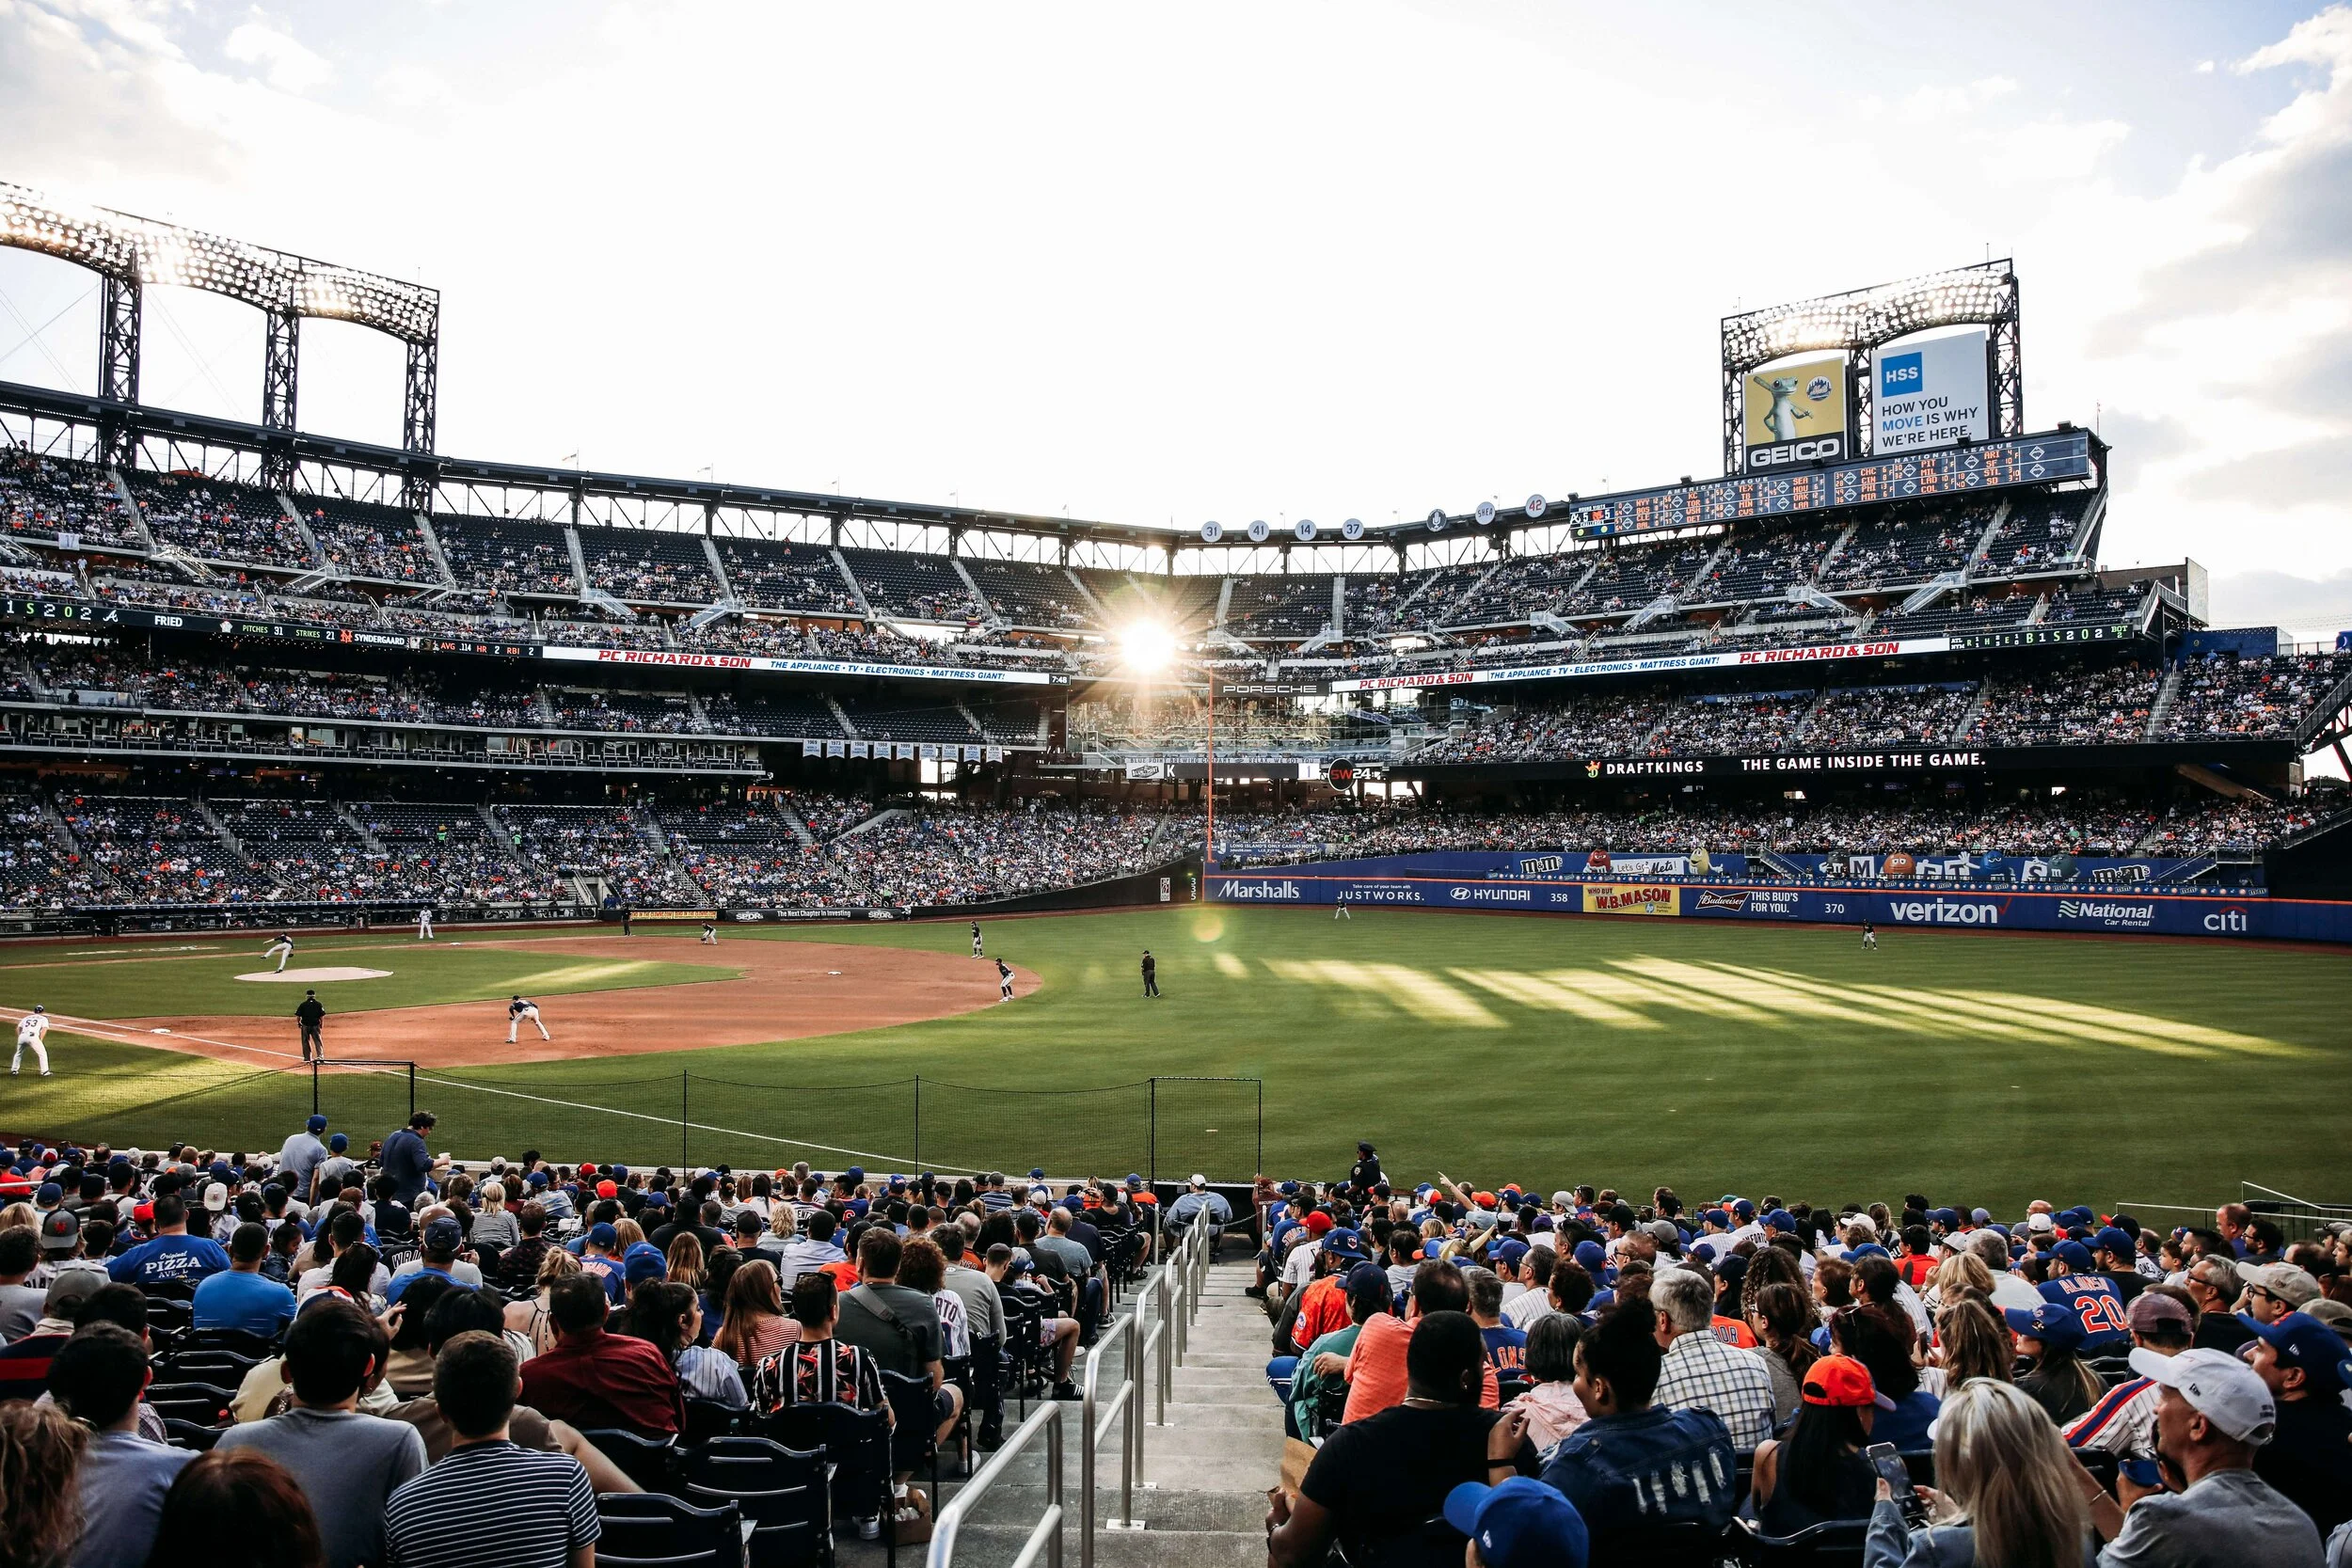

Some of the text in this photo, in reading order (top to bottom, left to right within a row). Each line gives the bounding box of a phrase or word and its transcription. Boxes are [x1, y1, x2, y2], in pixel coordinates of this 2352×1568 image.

[1885, 367, 1918, 384] HSS
[1882, 396, 1948, 417] HOW YOU
[1882, 406, 1979, 432] MOVE IS WHY
[1882, 425, 1972, 448] WE'RE HERE.
[1750, 437, 1840, 467] GEICO
[1894, 442, 2012, 464] NATIONAL LEAGUE
[1983, 451, 2000, 460] ARI
[1920, 459, 1936, 468] PIT
[1986, 460, 1996, 468] SF
[1860, 467, 1877, 476] CHC
[1920, 467, 1936, 477] MIL
[1983, 468, 2001, 477] STL
[1861, 476, 1876, 484] CIN
[1920, 476, 1937, 485] LAD
[1667, 476, 1769, 496] AMERICAN LEAGUE
[1739, 484, 1754, 493] TEX
[1861, 483, 1876, 493] PHI
[1920, 485, 1937, 494] COL
[1688, 492, 1698, 500] KC
[1740, 492, 1751, 500] TB
[1861, 492, 1877, 501] MIA
[1529, 499, 1542, 511] 42
[1686, 499, 1701, 508] TOR
[1477, 507, 1493, 518] SHEA
[1738, 508, 1754, 516] CWS
[1206, 527, 1217, 537] 31
[1253, 525, 1265, 536] 41
[1300, 524, 1311, 535] 14
[1346, 524, 1359, 534] 37
[7, 600, 14, 614] 1
[26, 603, 35, 614] S
[43, 603, 56, 617] 2
[80, 607, 91, 621] 2
[154, 614, 183, 627] FRIED
[242, 624, 268, 634] PITCHES
[274, 626, 283, 636] 31
[295, 628, 321, 639] STRIKES
[326, 630, 335, 641] 21
[2005, 636, 2010, 644] E
[2026, 633, 2034, 643] B
[2040, 632, 2046, 642] 1
[2053, 631, 2060, 641] S
[2066, 629, 2074, 641] 2
[2094, 627, 2103, 639] 2
[354, 634, 405, 646] SYNDERGAARD
[440, 641, 455, 651] AVG
[459, 642, 471, 652] .114
[476, 645, 487, 654] HR
[494, 645, 501, 655] 2
[506, 646, 519, 656] RBI
[529, 647, 534, 657] 2
[1984, 638, 1991, 646] H
[1739, 641, 1899, 664] P.C. RICHARD & SON
[598, 650, 752, 668] P.C. RICHARD & SON
[789, 662, 841, 673] APPLIANCE
[865, 666, 926, 676] ELECTRONICS
[931, 669, 976, 679] MATTRESS
[1490, 671, 1505, 680] THE
[1507, 668, 1551, 678] APPLIANCE
[1574, 662, 1633, 673] ELECTRONICS
[1639, 659, 1687, 669] MATTRESS
[1689, 657, 1720, 666] GIANT!
[1051, 675, 1068, 685] 7:48
[1376, 674, 1436, 688] RICHARD
[1436, 673, 1445, 684] &
[1448, 673, 1473, 683] SON
[1223, 685, 1317, 693] PORSCHE
[1606, 752, 1986, 775] DRAFTKINGS THE GAME INSIDE THE GAME.
[1168, 765, 1175, 777] K
[1617, 863, 1633, 873] Let's
[1853, 860, 1870, 877] M
[1217, 879, 1300, 899] Marshalls
[1337, 891, 1424, 901] JUSTWORKS.
[1473, 889, 1531, 901] HYUNDAI
[1550, 894, 1568, 903] 358
[1699, 895, 1745, 906] Budweiser
[1751, 892, 1799, 903] THIS BUD'S
[1751, 902, 1789, 913] FOR YOU.
[1824, 903, 1845, 914] 370
[1890, 897, 1998, 924] verizon
[2078, 900, 2153, 919] National
[800, 910, 818, 919] Chapter
[826, 910, 851, 918] Investing
[2203, 911, 2247, 931] citi
[160, 1250, 188, 1261] Original
[145, 1257, 202, 1274] PIZZA
[158, 1270, 180, 1278] AVE.
[2058, 1275, 2110, 1294] ALONSO
[935, 1297, 959, 1323] RTO
[2074, 1294, 2129, 1334] 20
[1487, 1345, 1526, 1374] LONS
